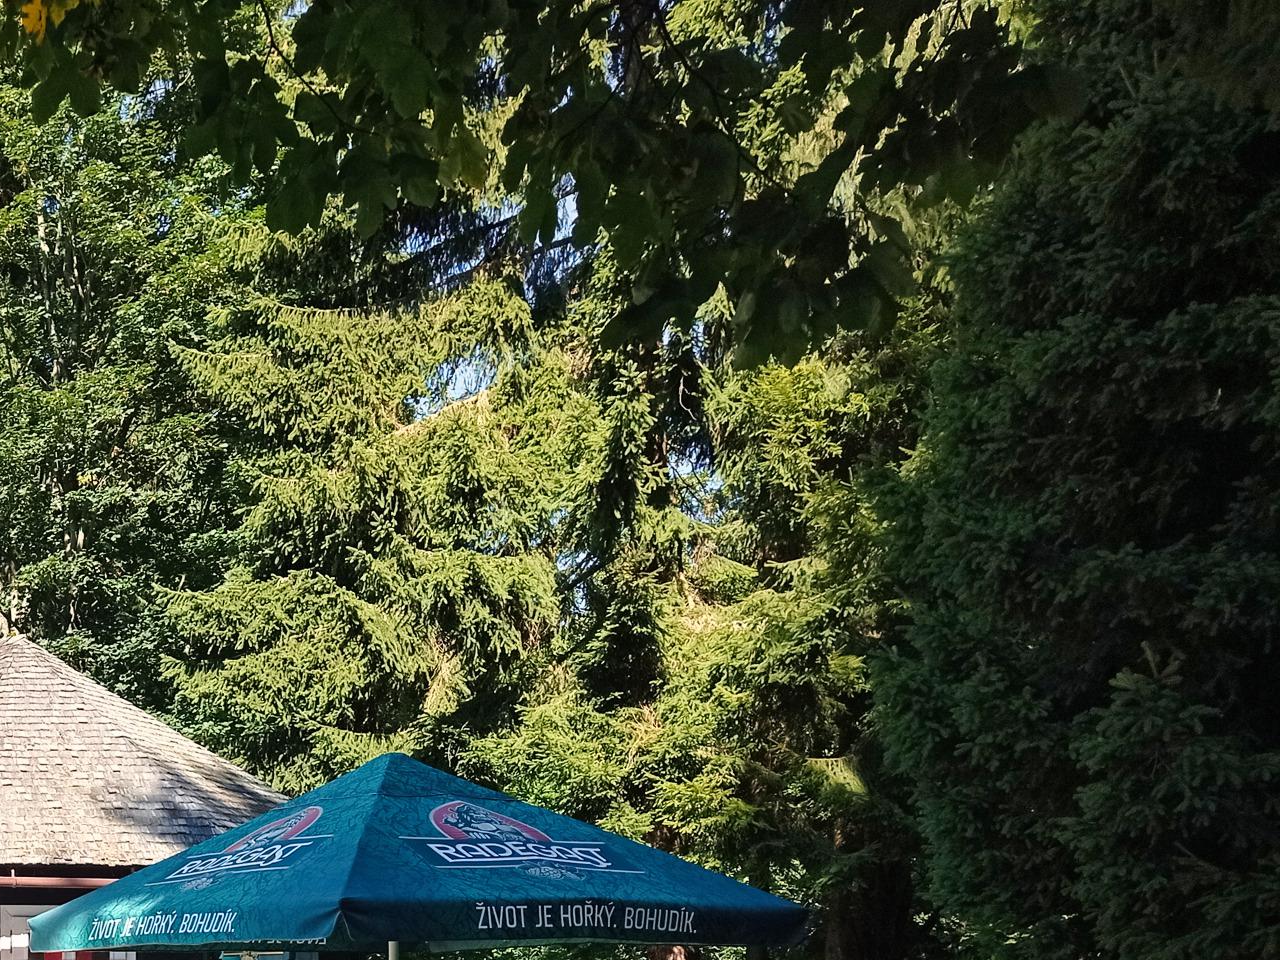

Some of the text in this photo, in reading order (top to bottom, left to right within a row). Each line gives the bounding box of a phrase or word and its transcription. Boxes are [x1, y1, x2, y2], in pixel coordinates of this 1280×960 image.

[168, 841, 314, 878] RADEGAST
[427, 842, 612, 867] RADEGAST
[88, 908, 238, 941] ŽIVOT JE HOŘKÝ. BOHUDÍK.
[476, 900, 698, 934] ŽIVOT JE HOŘKÝ. BOHUDÍK.
